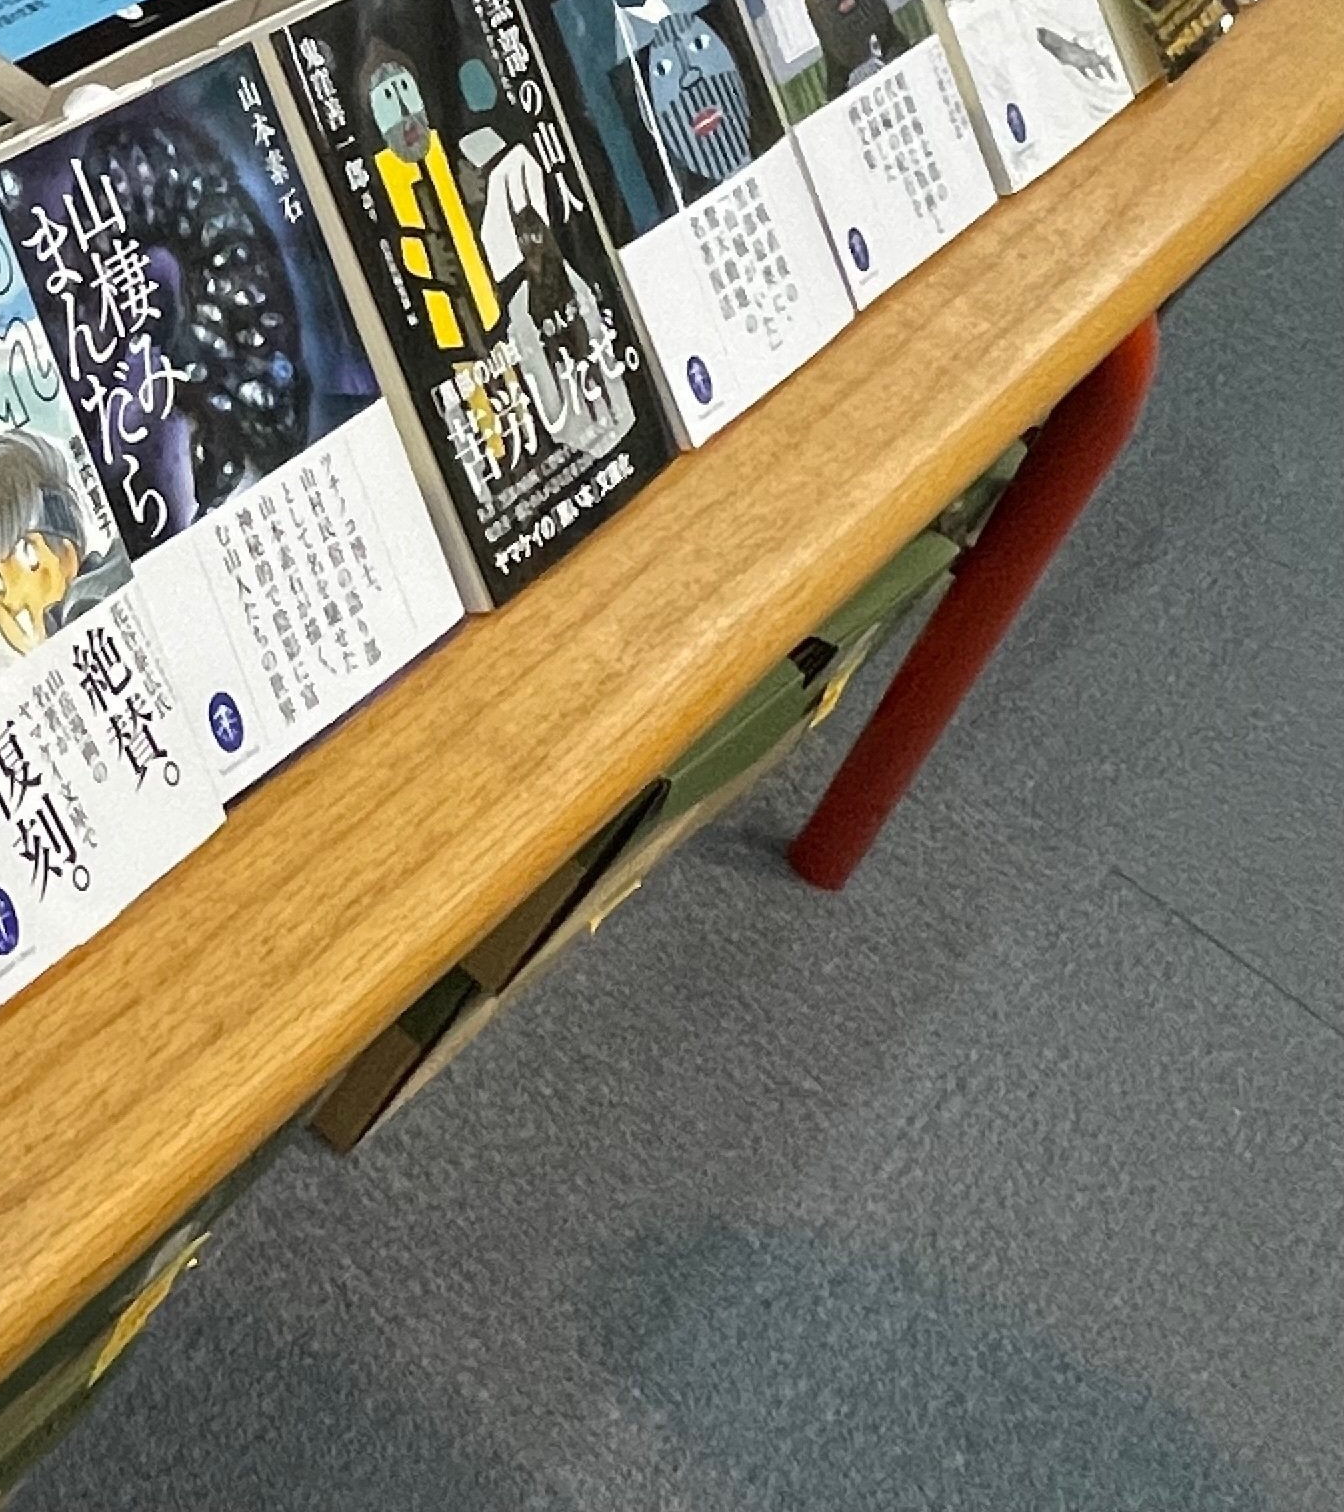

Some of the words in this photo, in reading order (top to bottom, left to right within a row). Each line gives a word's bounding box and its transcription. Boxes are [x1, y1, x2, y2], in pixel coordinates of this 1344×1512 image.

[236, 75, 304, 224] 山本素石
[21, 205, 169, 540] まんだら
[61, 157, 190, 419] 山棲み
[445, 321, 642, 488] 苦労したぜ。
[71, 611, 180, 789] 絶賛。
